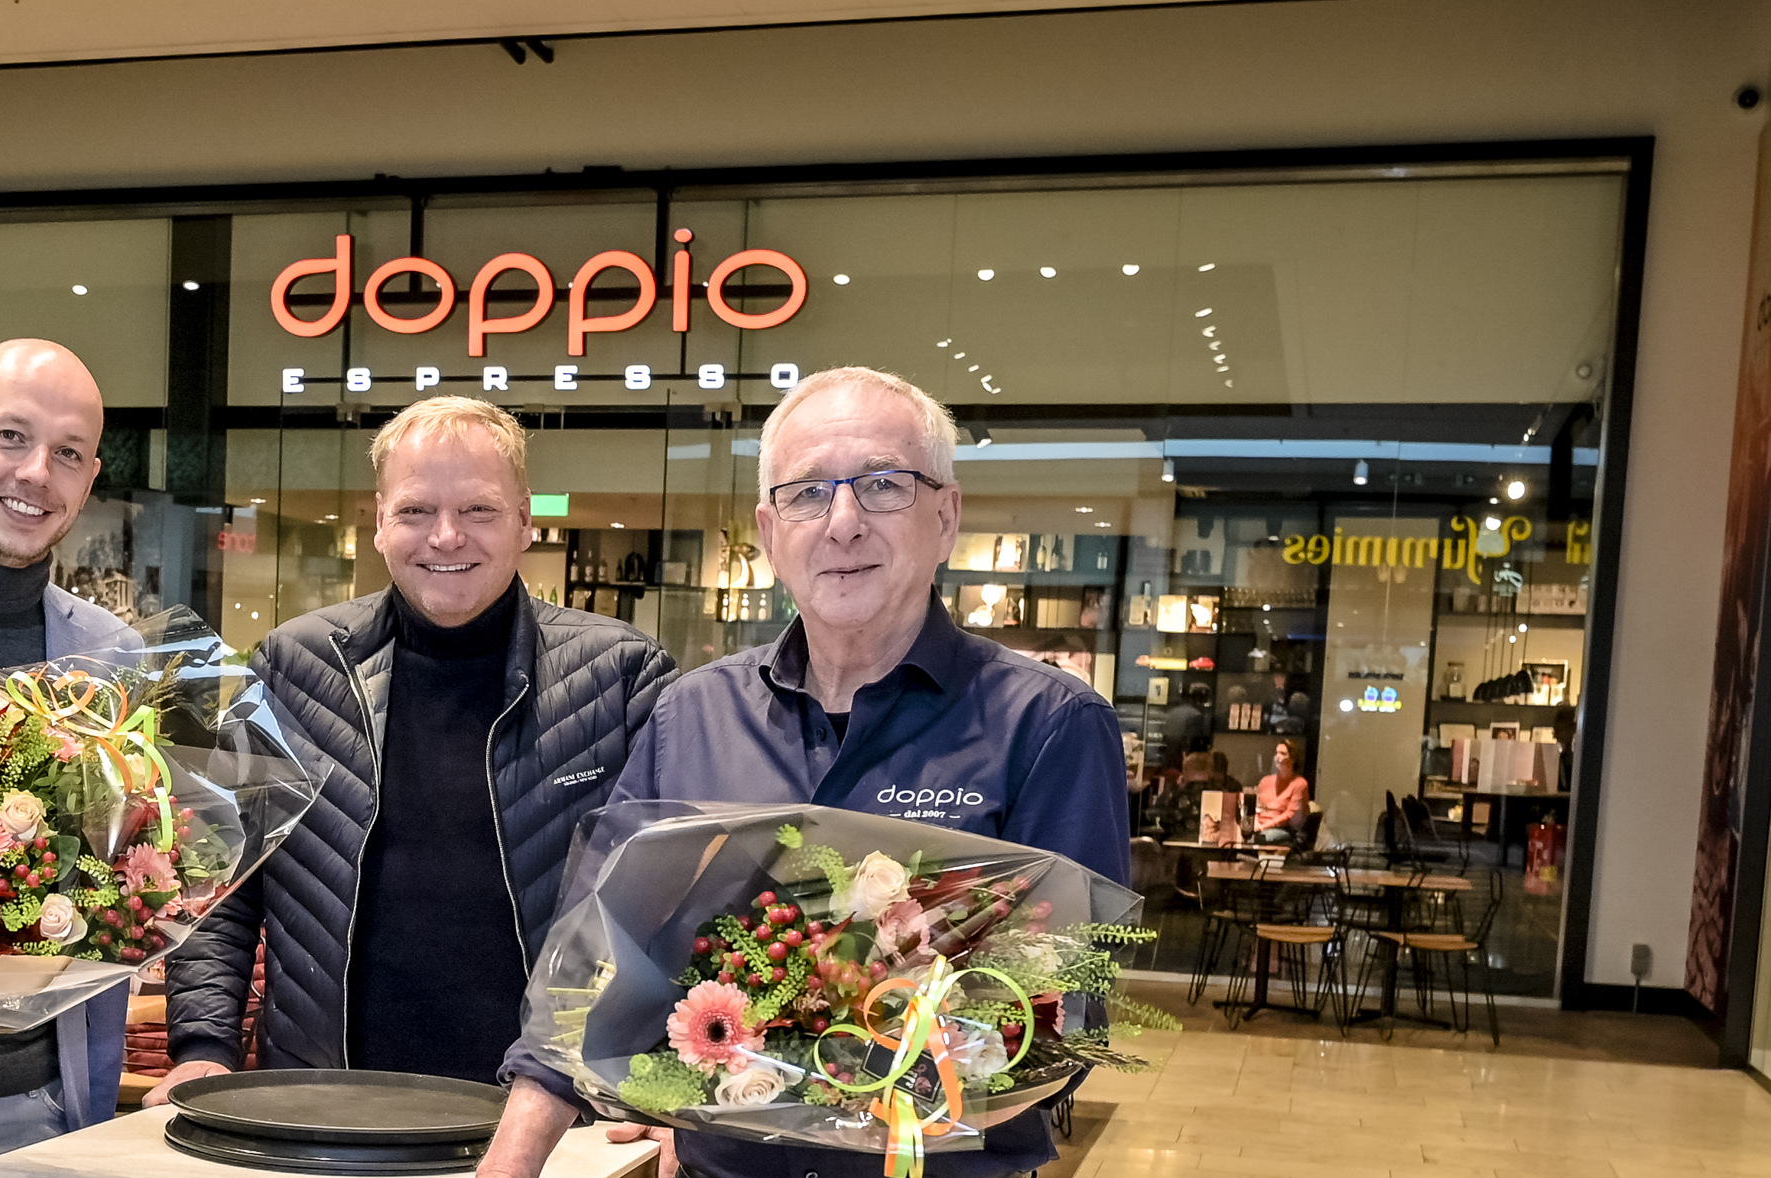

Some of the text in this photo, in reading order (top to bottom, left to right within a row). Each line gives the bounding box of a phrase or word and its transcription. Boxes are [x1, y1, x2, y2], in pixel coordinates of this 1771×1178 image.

[270, 228, 807, 357] doppio
[281, 362, 800, 394] ESPRESSO
[876, 784, 984, 807] doppio
[903, 809, 947, 819] dal 2007
